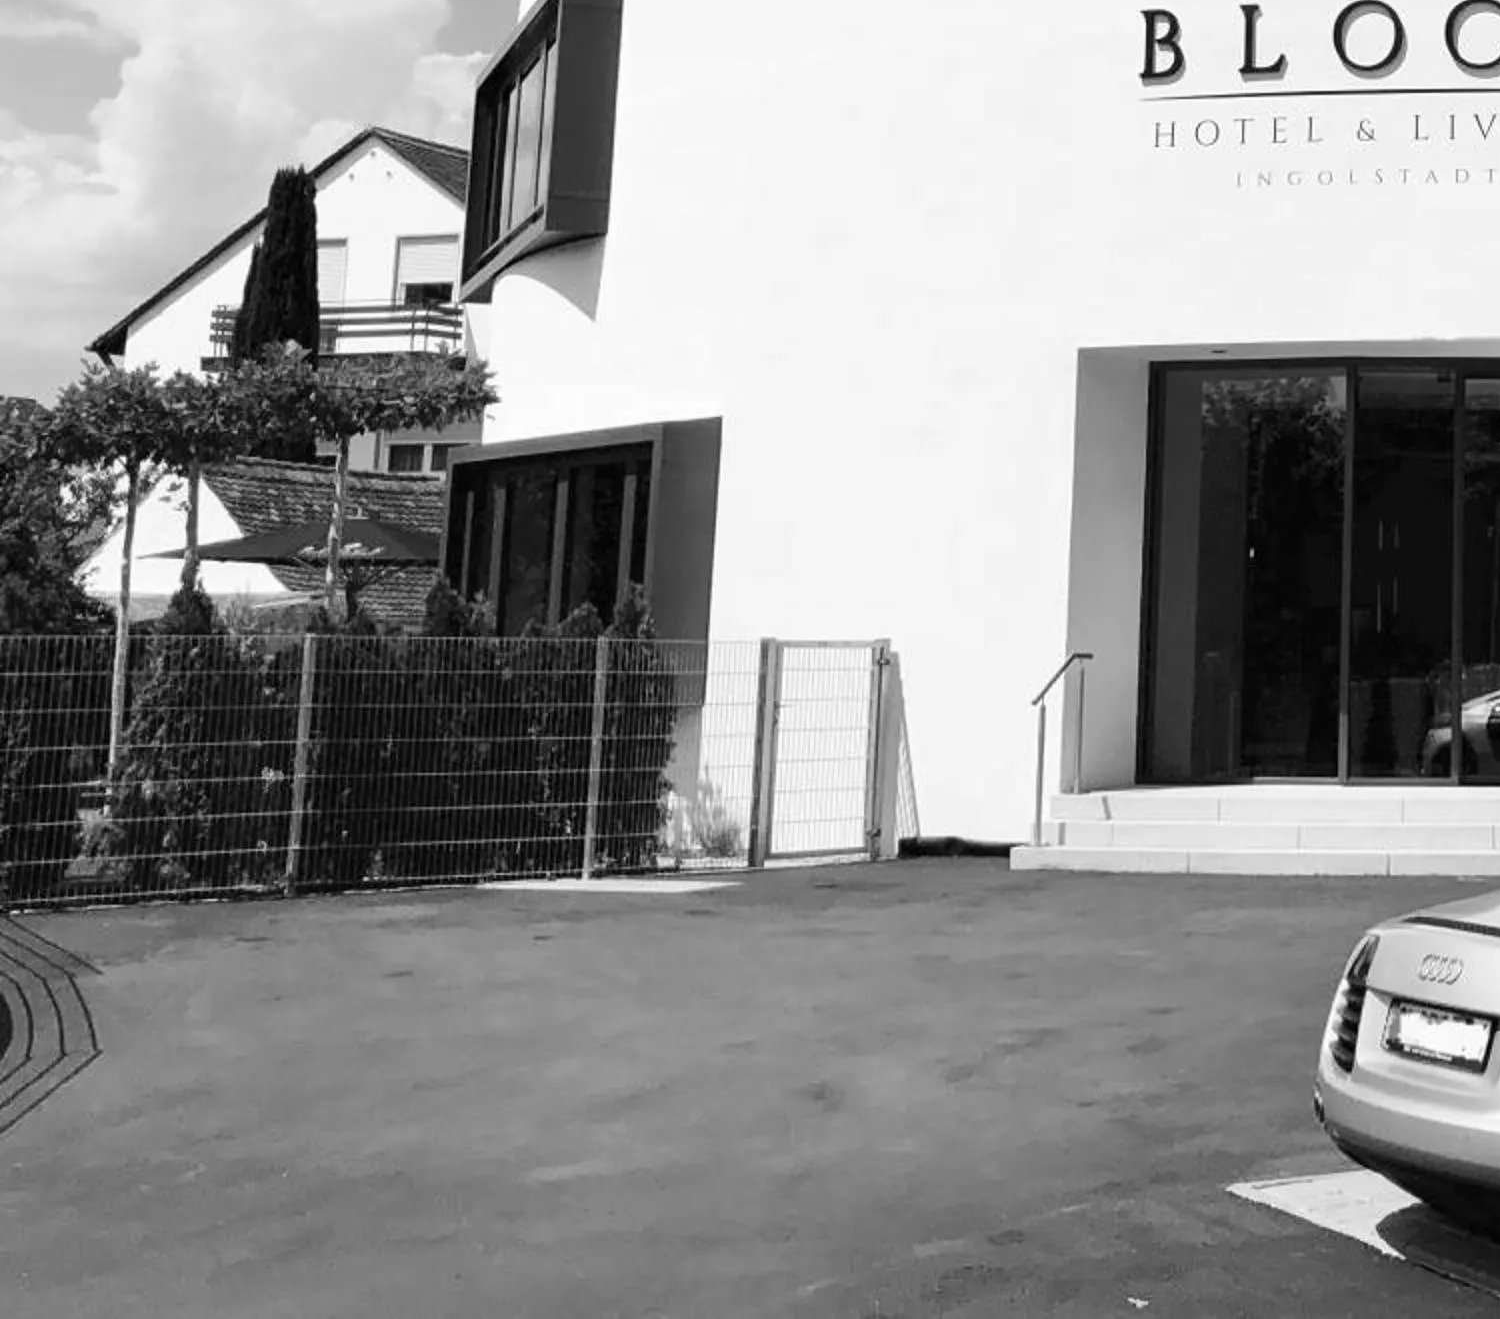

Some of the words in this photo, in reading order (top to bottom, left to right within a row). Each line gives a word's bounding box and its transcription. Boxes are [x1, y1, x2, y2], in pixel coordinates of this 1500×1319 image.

[1153, 116, 1324, 149] HOTEL
[1355, 120, 1377, 143] &
[1236, 168, 1499, 188] INGOLSTADT
